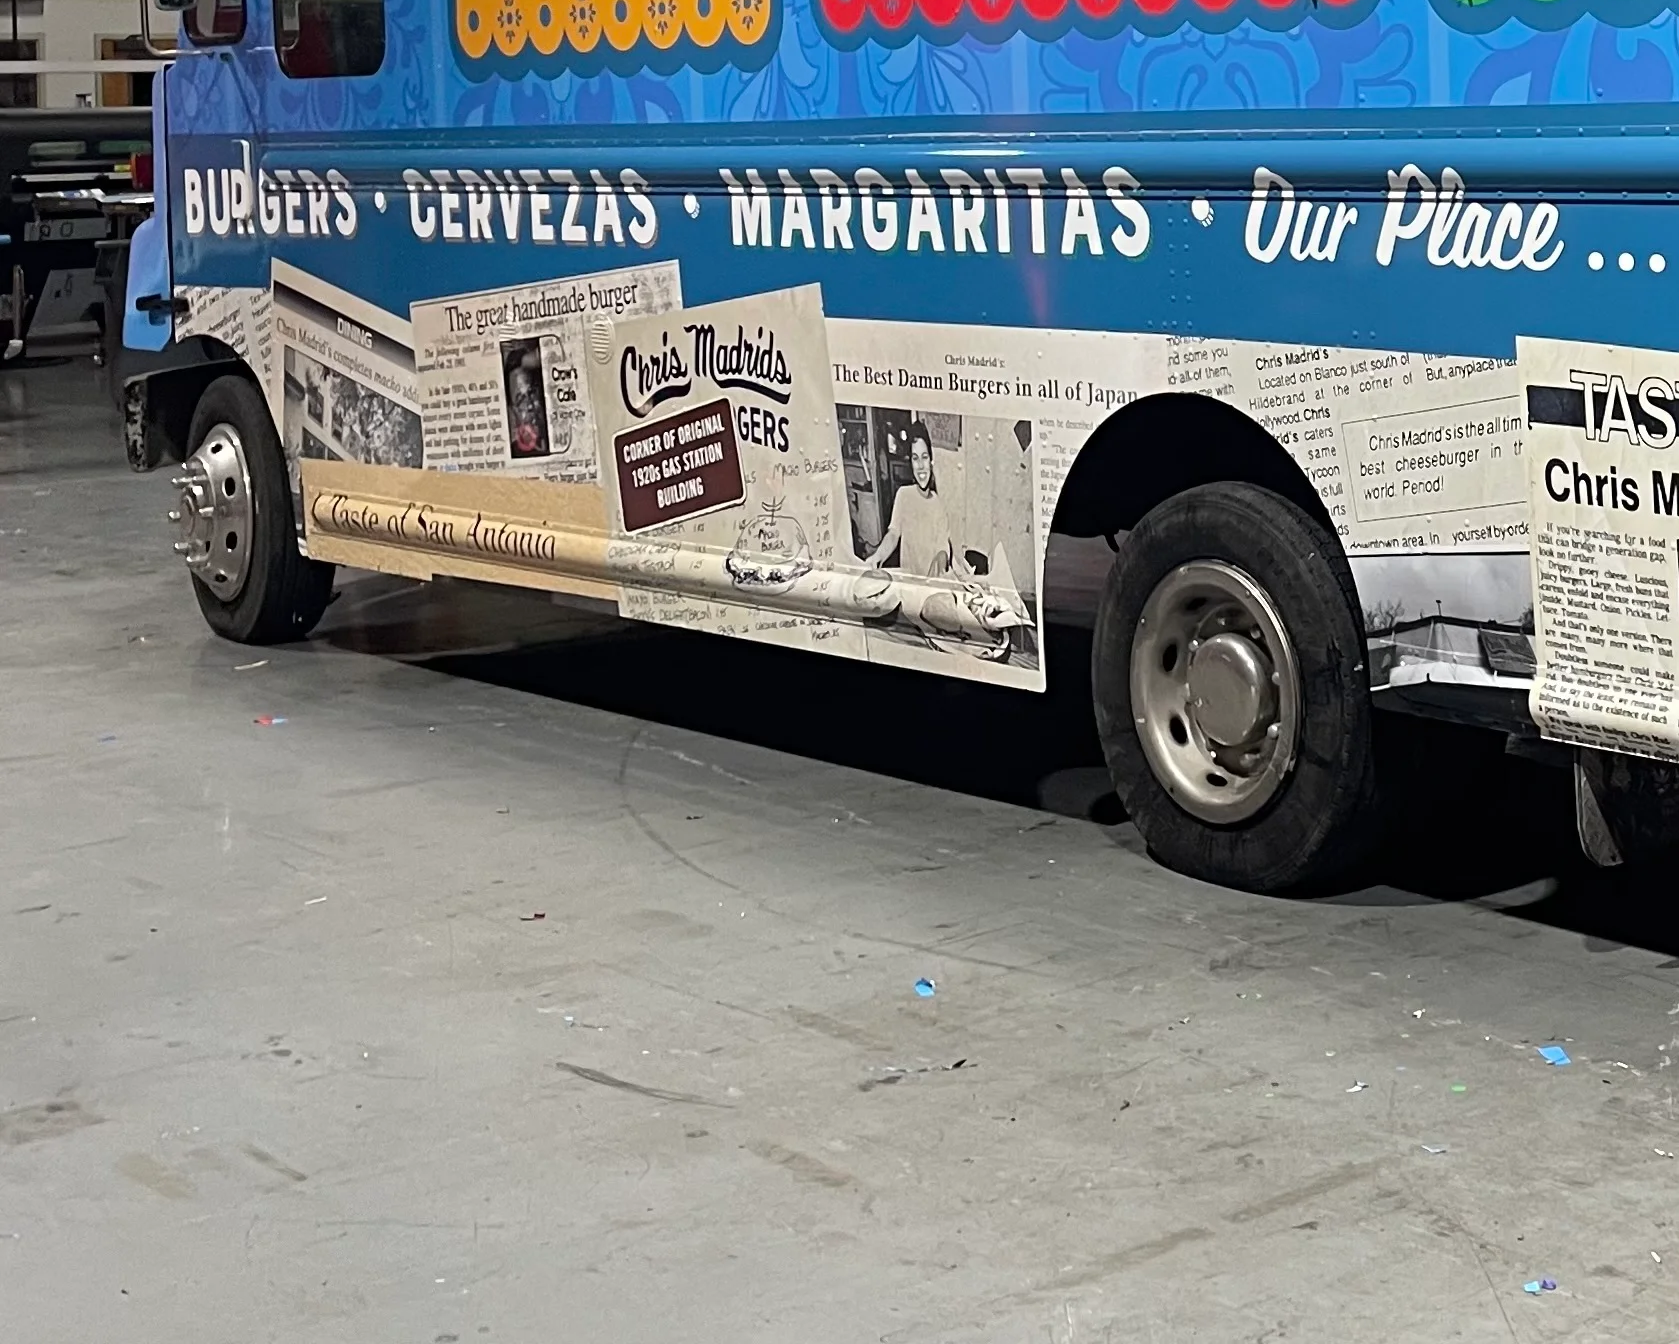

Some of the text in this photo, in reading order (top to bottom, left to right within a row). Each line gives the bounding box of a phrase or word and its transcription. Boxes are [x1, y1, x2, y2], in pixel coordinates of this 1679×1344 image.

[184, 167, 359, 238] BURGERS
[402, 167, 659, 246] CERVEZAS
[727, 164, 1152, 259] MARGARITAS
[1243, 165, 1356, 264] Our
[1375, 162, 1563, 273] Place
[445, 283, 638, 335] The great handmade burger
[337, 317, 373, 349] DINING
[276, 317, 296, 341] Chris
[299, 328, 333, 359] Madrid's
[333, 348, 373, 381] completes
[374, 370, 401, 394] macho
[620, 324, 792, 419] Chris Madrids
[944, 354, 966, 366] Chris
[1184, 349, 1208, 364] some
[1212, 347, 1228, 362] you
[1255, 348, 1329, 370] Chris Madrid's
[1258, 352, 1409, 390] Located on Blanco just south of
[1426, 367, 1447, 381] But,
[1449, 359, 1494, 379] anyplace
[832, 363, 1138, 410] The Best Damn Burgers in all of Japan
[1249, 371, 1413, 410] Hildebrand at the corner of
[736, 405, 790, 453] GERS
[1303, 406, 1331, 422] Chris
[623, 413, 725, 464] CORNER OF ORIGINAL
[1304, 426, 1334, 441] caters
[1369, 434, 1400, 452] Chris
[1402, 425, 1452, 448] Madrid's
[1454, 423, 1464, 439] is
[1465, 420, 1484, 437] the
[1487, 417, 1500, 434] all
[632, 442, 724, 488] 1920s GAS STATION
[1308, 444, 1337, 460] same
[1360, 460, 1385, 477] best
[1395, 447, 1480, 473] cheeseburger
[1490, 443, 1501, 459] in
[657, 477, 704, 509] BUILDING
[1364, 475, 1444, 501] world. Period!
[1544, 456, 1639, 514] Chris
[388, 502, 415, 539] of
[417, 504, 455, 546] San
[467, 512, 556, 561] Antonio
[1402, 534, 1427, 547] area.
[1429, 532, 1440, 546] In
